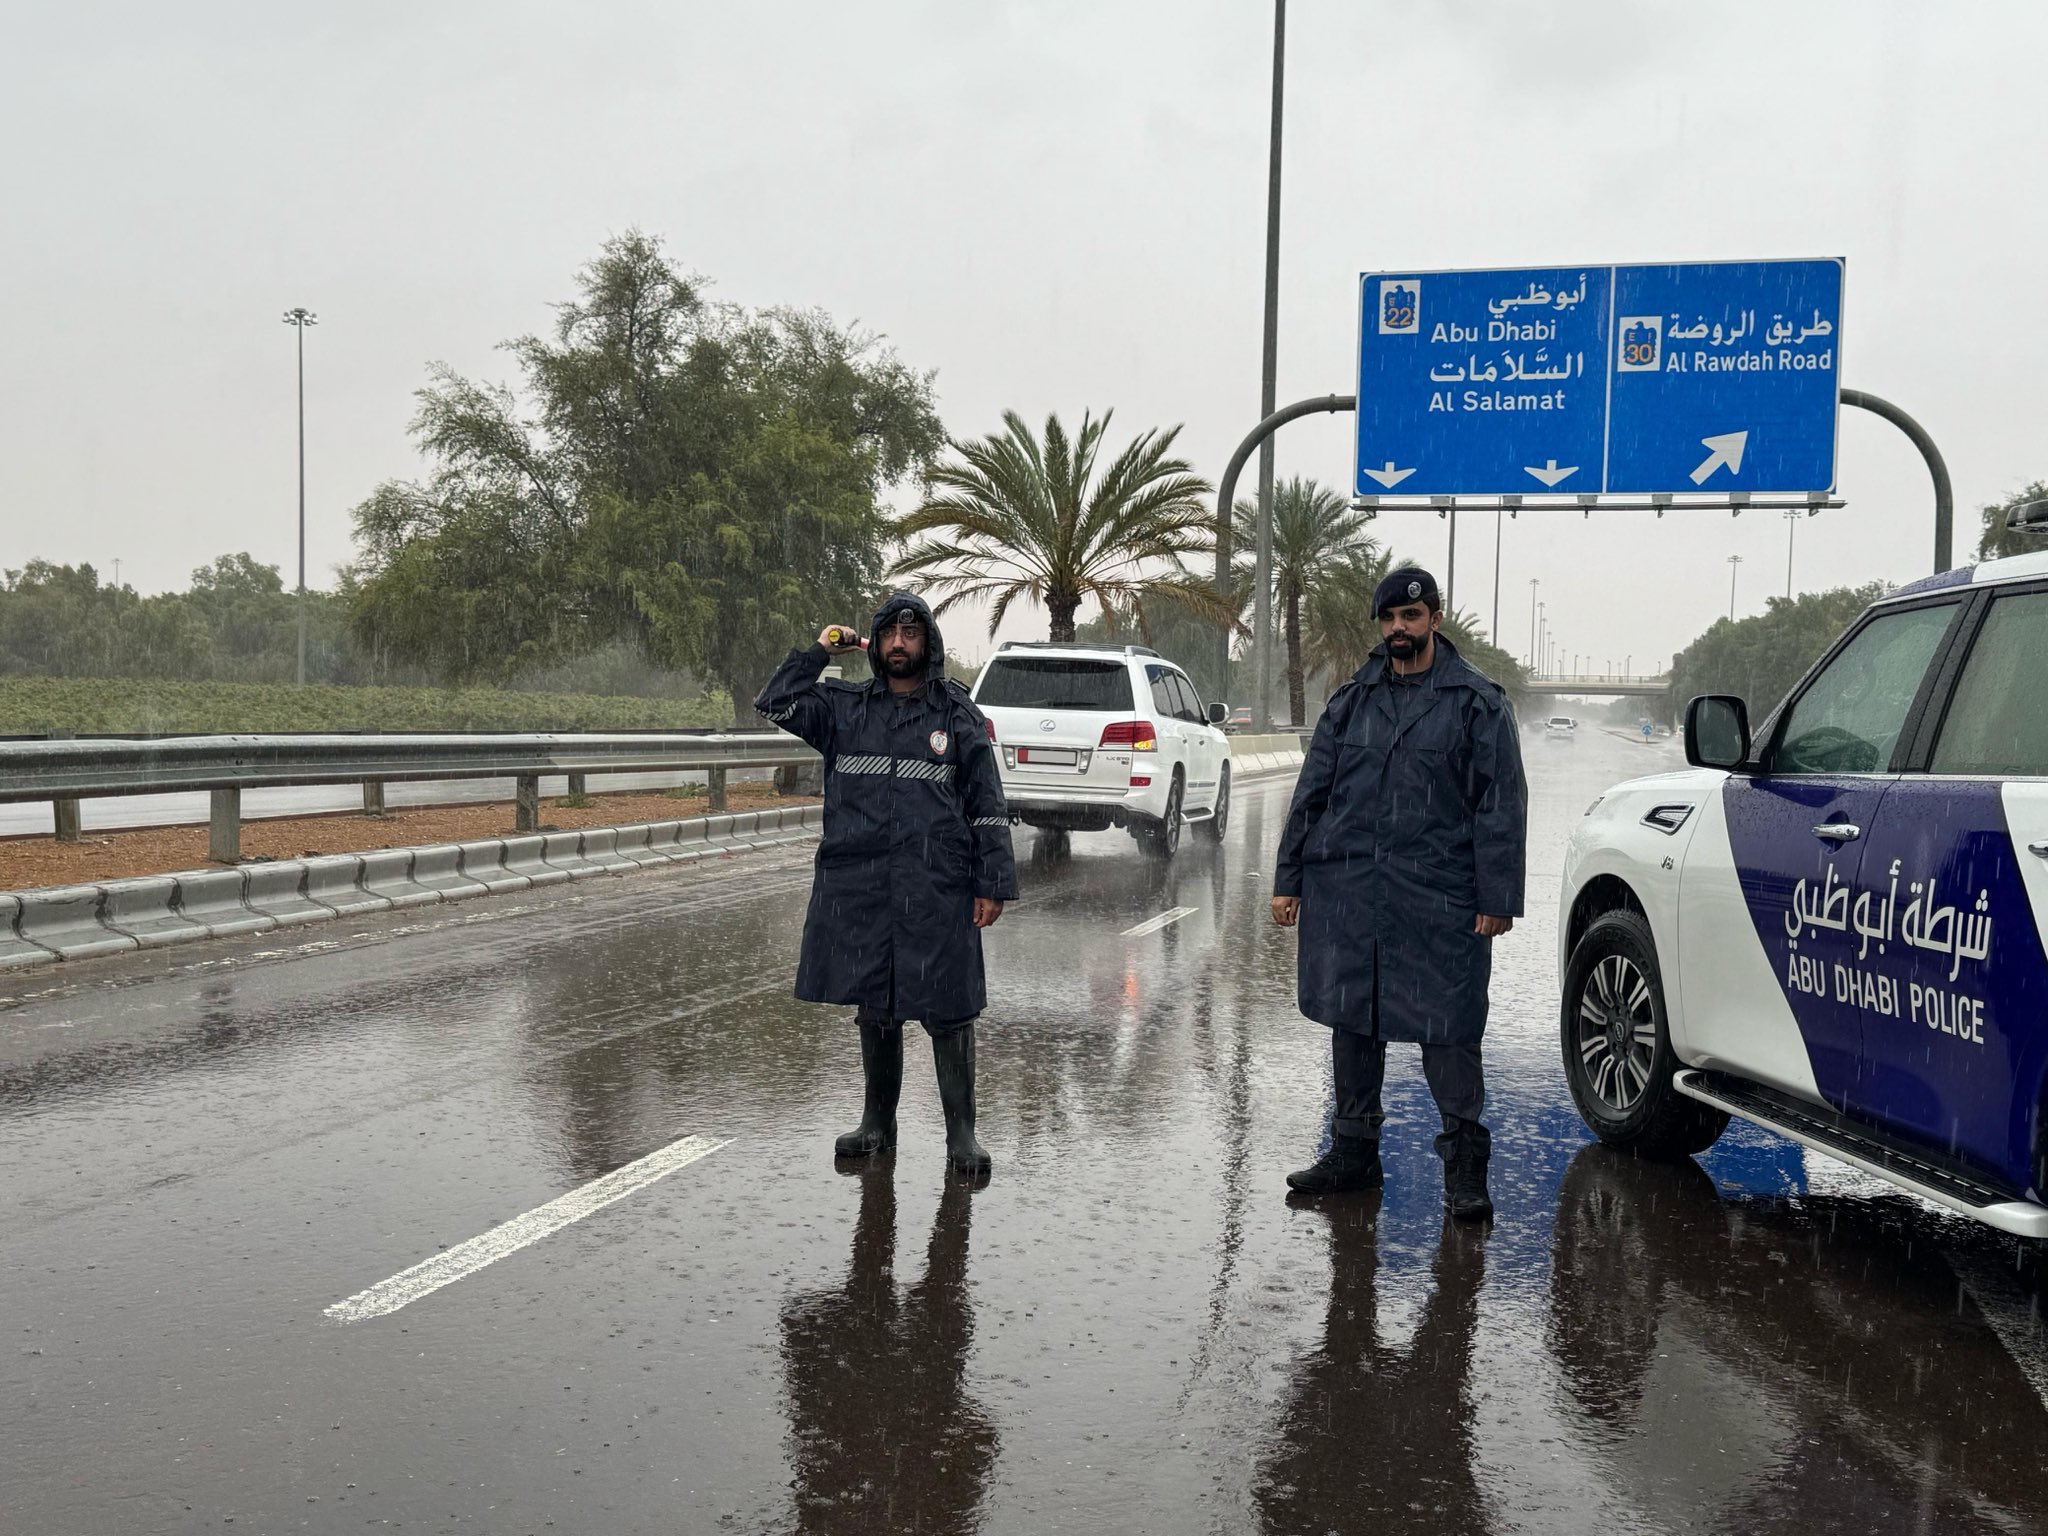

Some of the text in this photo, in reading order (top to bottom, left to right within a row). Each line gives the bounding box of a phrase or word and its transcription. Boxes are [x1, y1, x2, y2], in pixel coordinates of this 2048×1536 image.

[1387, 307, 1412, 326] 22
[1667, 308, 1833, 346] طريق الروضة
[1430, 319, 1556, 343] Abu Dhabi
[1625, 343, 1653, 363] 30
[1666, 348, 1832, 373] Al Rawdah Road
[1428, 389, 1566, 412] Al Salamat
[1901, 878, 1993, 983] شرطة
[1787, 953, 1985, 1046] ABU DHABI POLICE
